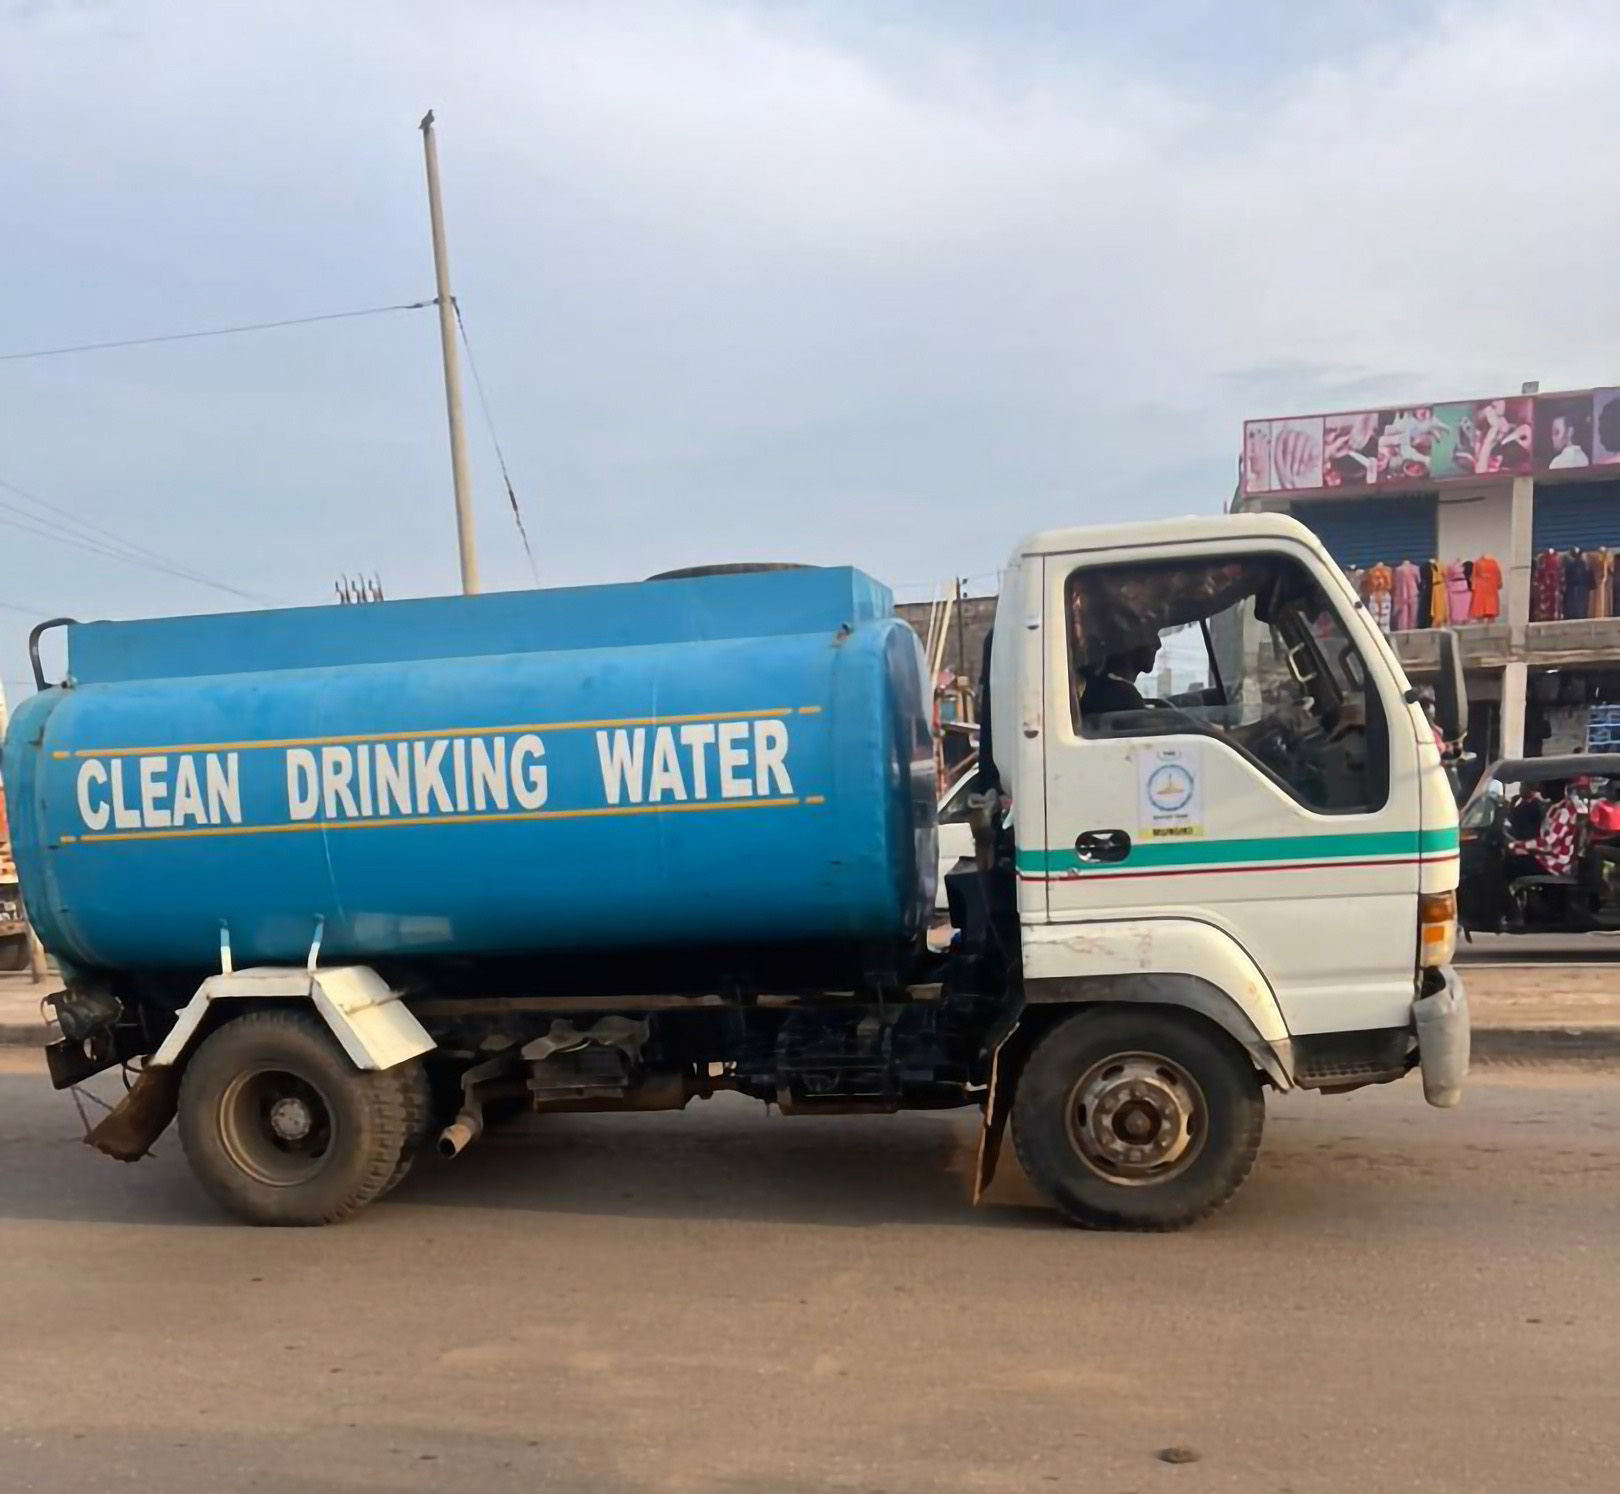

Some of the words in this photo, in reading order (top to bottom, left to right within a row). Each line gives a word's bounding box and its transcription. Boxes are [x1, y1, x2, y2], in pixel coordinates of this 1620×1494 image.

[76, 752, 242, 831] CLEAN
[286, 734, 548, 821] DRINKING
[595, 719, 794, 805] WATER
